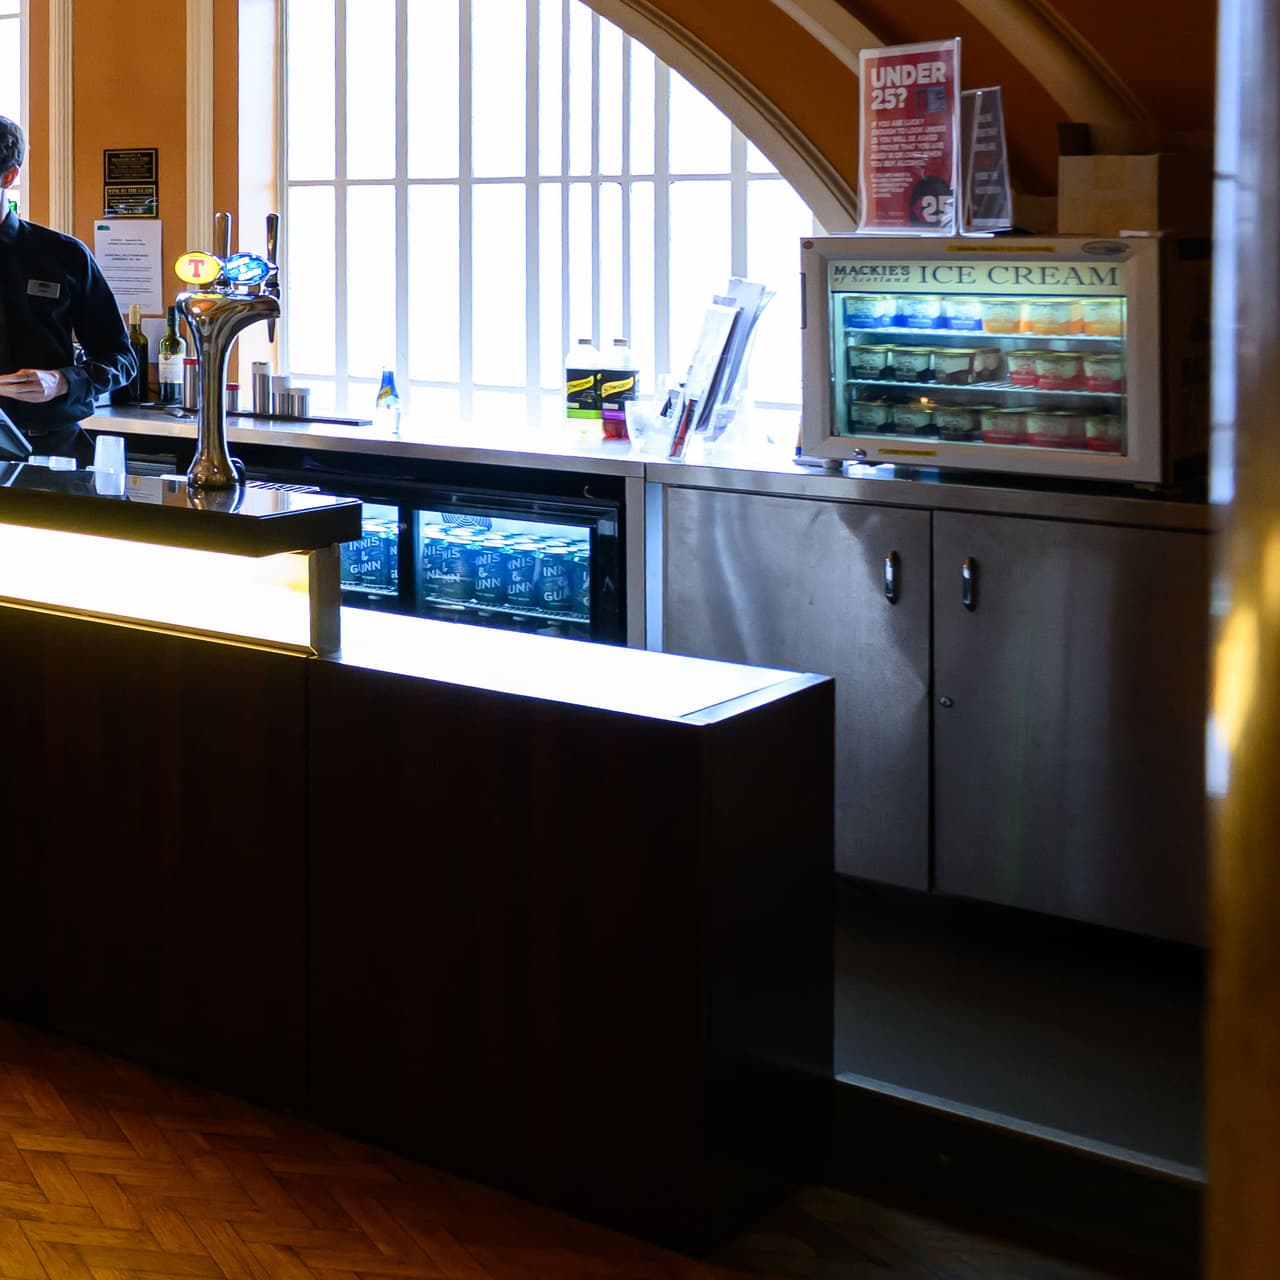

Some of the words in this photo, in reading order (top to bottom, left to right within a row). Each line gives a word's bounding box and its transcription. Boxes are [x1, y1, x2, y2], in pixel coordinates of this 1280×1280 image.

[871, 62, 947, 89] UNDER
[871, 87, 908, 111] 25?
[188, 258, 205, 279] T
[834, 264, 911, 276] MACKIE'S
[918, 265, 977, 284] ICE
[987, 265, 1121, 287] CREAM
